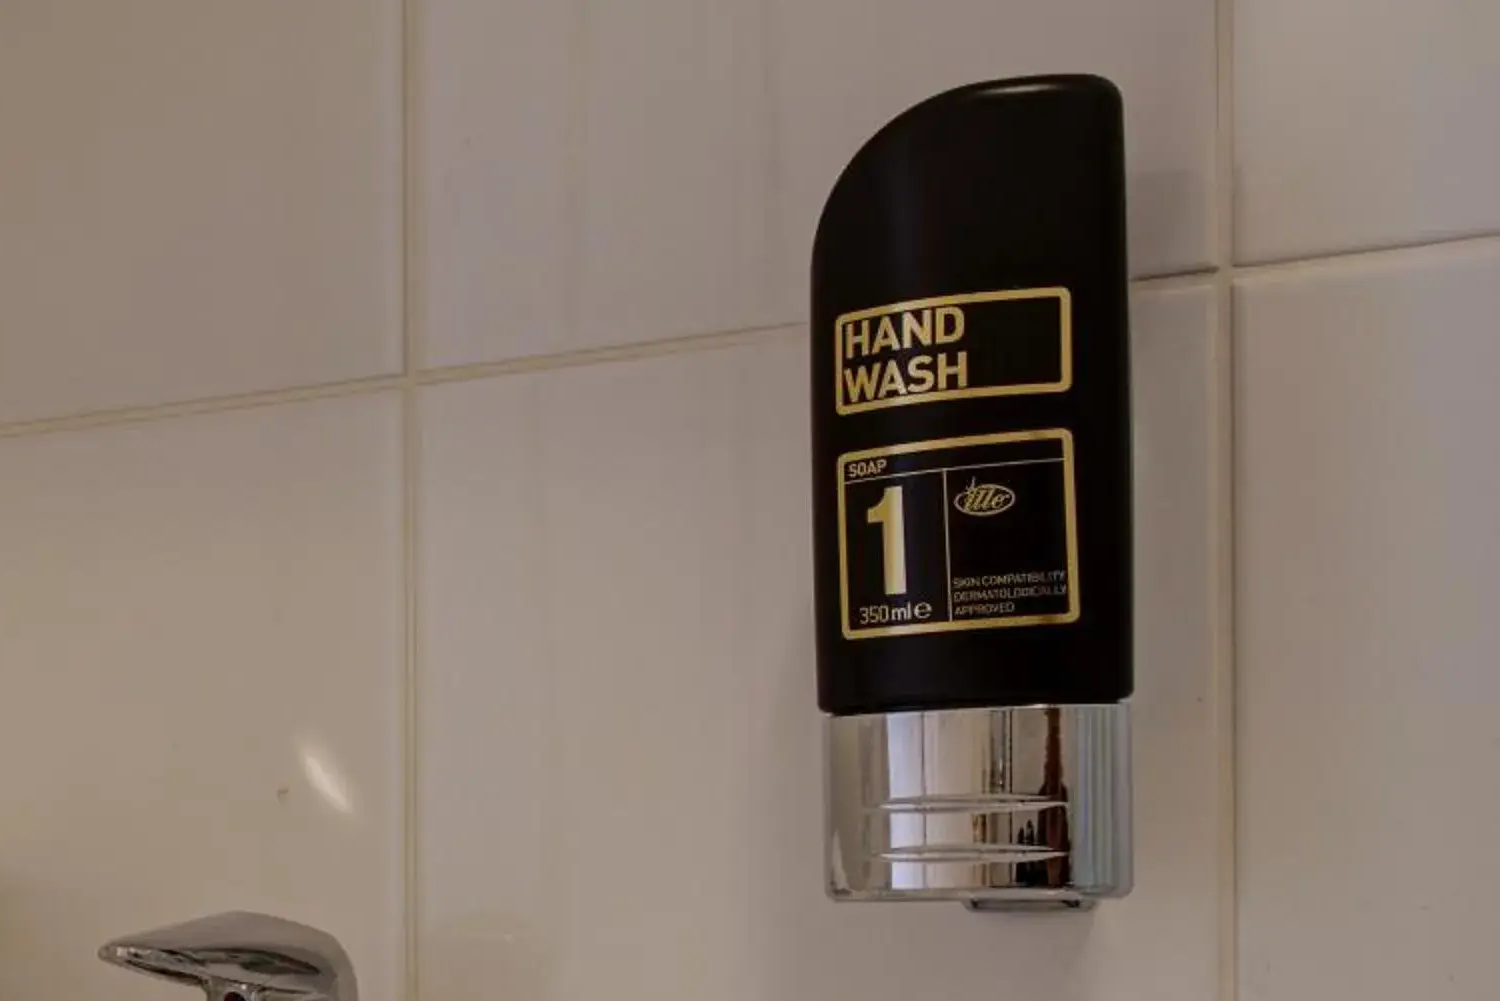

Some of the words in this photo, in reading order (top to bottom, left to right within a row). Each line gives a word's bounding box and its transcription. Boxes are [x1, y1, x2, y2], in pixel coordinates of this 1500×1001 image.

[845, 306, 965, 359] HAND
[844, 351, 968, 402] WASH
[849, 459, 887, 478] SOAP
[867, 485, 907, 595] 1
